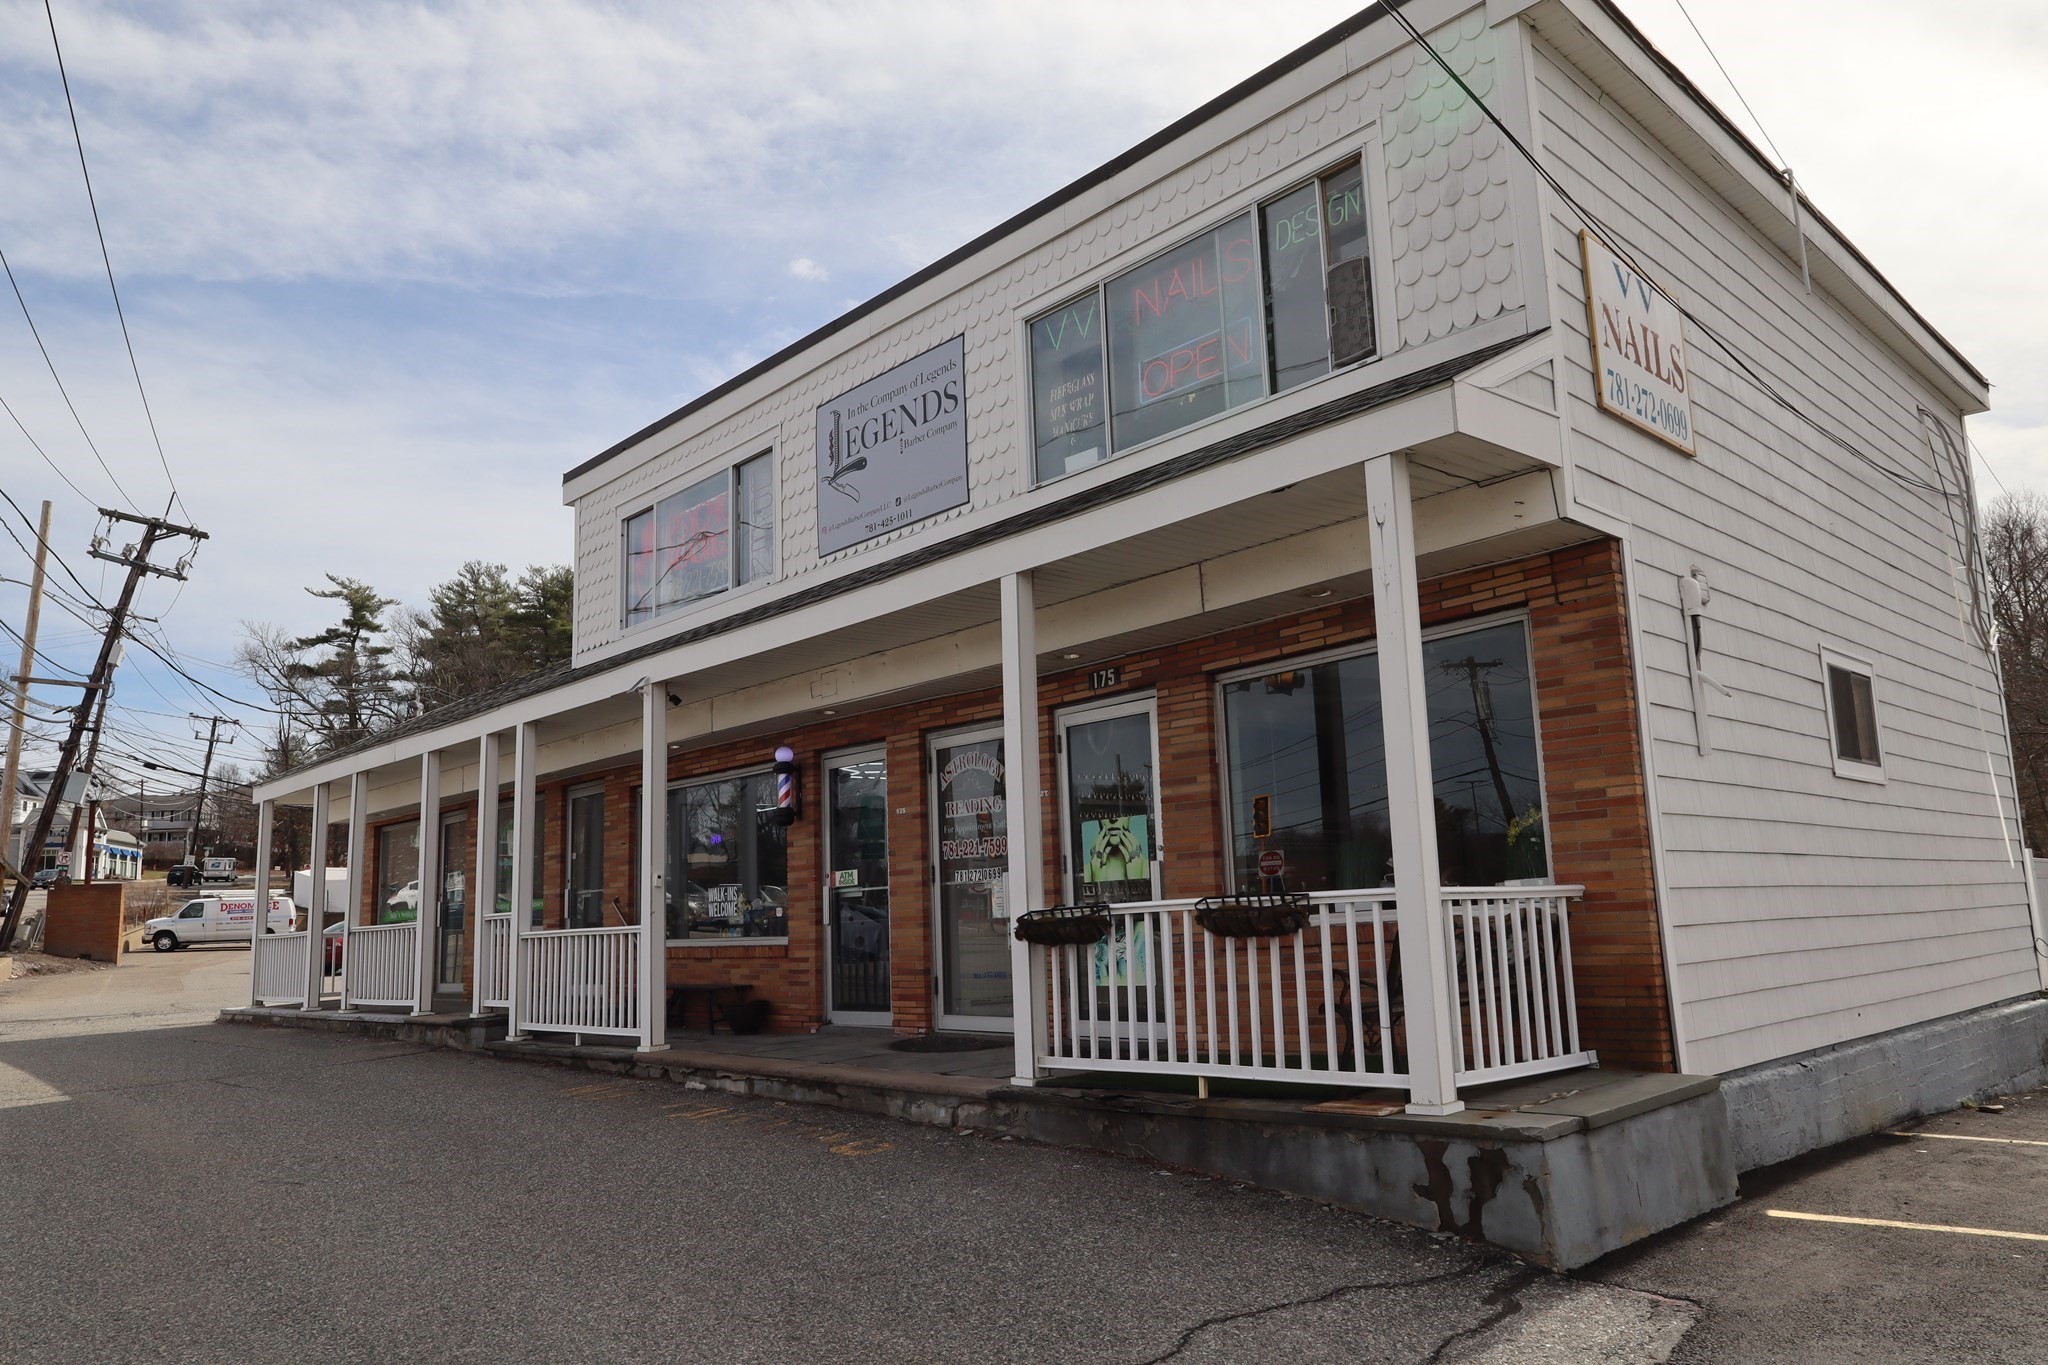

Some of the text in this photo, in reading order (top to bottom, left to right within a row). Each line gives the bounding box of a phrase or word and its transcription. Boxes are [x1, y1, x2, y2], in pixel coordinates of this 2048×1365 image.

[1276, 188, 1361, 251] DESGN
[1136, 239, 1253, 326] NAILS
[1599, 297, 1685, 394] NAILS
[1144, 326, 1250, 397] OPEN
[848, 358, 957, 420] In the Company of Legends
[904, 418, 960, 449] Barber Company
[864, 508, 912, 533] 781-425-1011
[1093, 668, 1116, 689] 175
[940, 751, 1006, 792] ASTROLOGY
[945, 795, 1003, 818] READING
[943, 825, 954, 834] For
[942, 836, 1007, 860] 781-221-7599
[839, 871, 854, 879] ATM
[708, 886, 738, 903] WALK-INS
[708, 902, 738, 917] WELCOME
